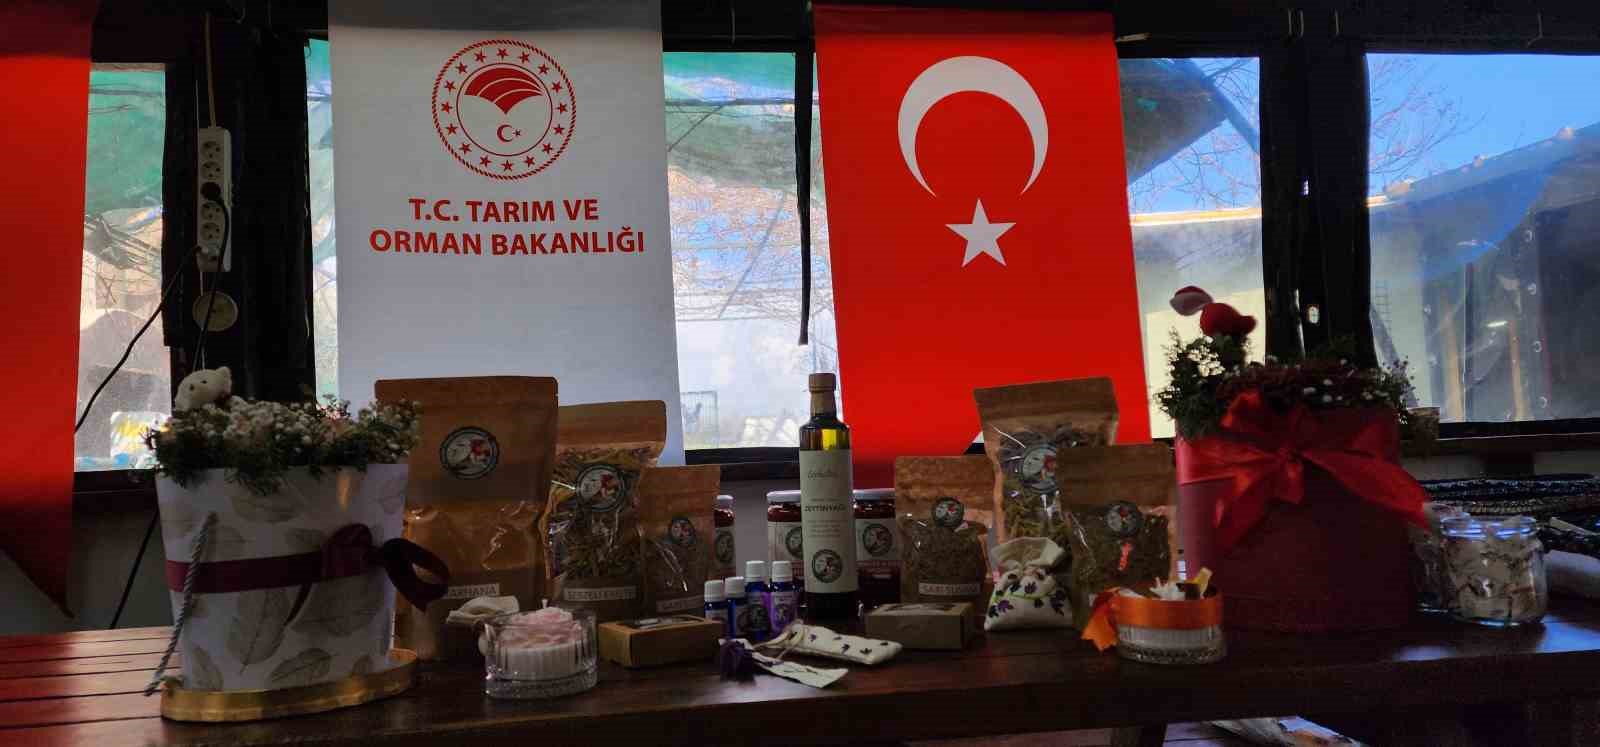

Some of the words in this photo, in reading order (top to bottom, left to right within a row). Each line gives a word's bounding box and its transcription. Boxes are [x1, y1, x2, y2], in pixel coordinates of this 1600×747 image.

[408, 198, 459, 221] T.C.
[465, 200, 555, 222] TARIM
[563, 199, 600, 221] VE
[369, 229, 482, 255] ORMAN
[491, 226, 644, 256] BAKANLIĞI
